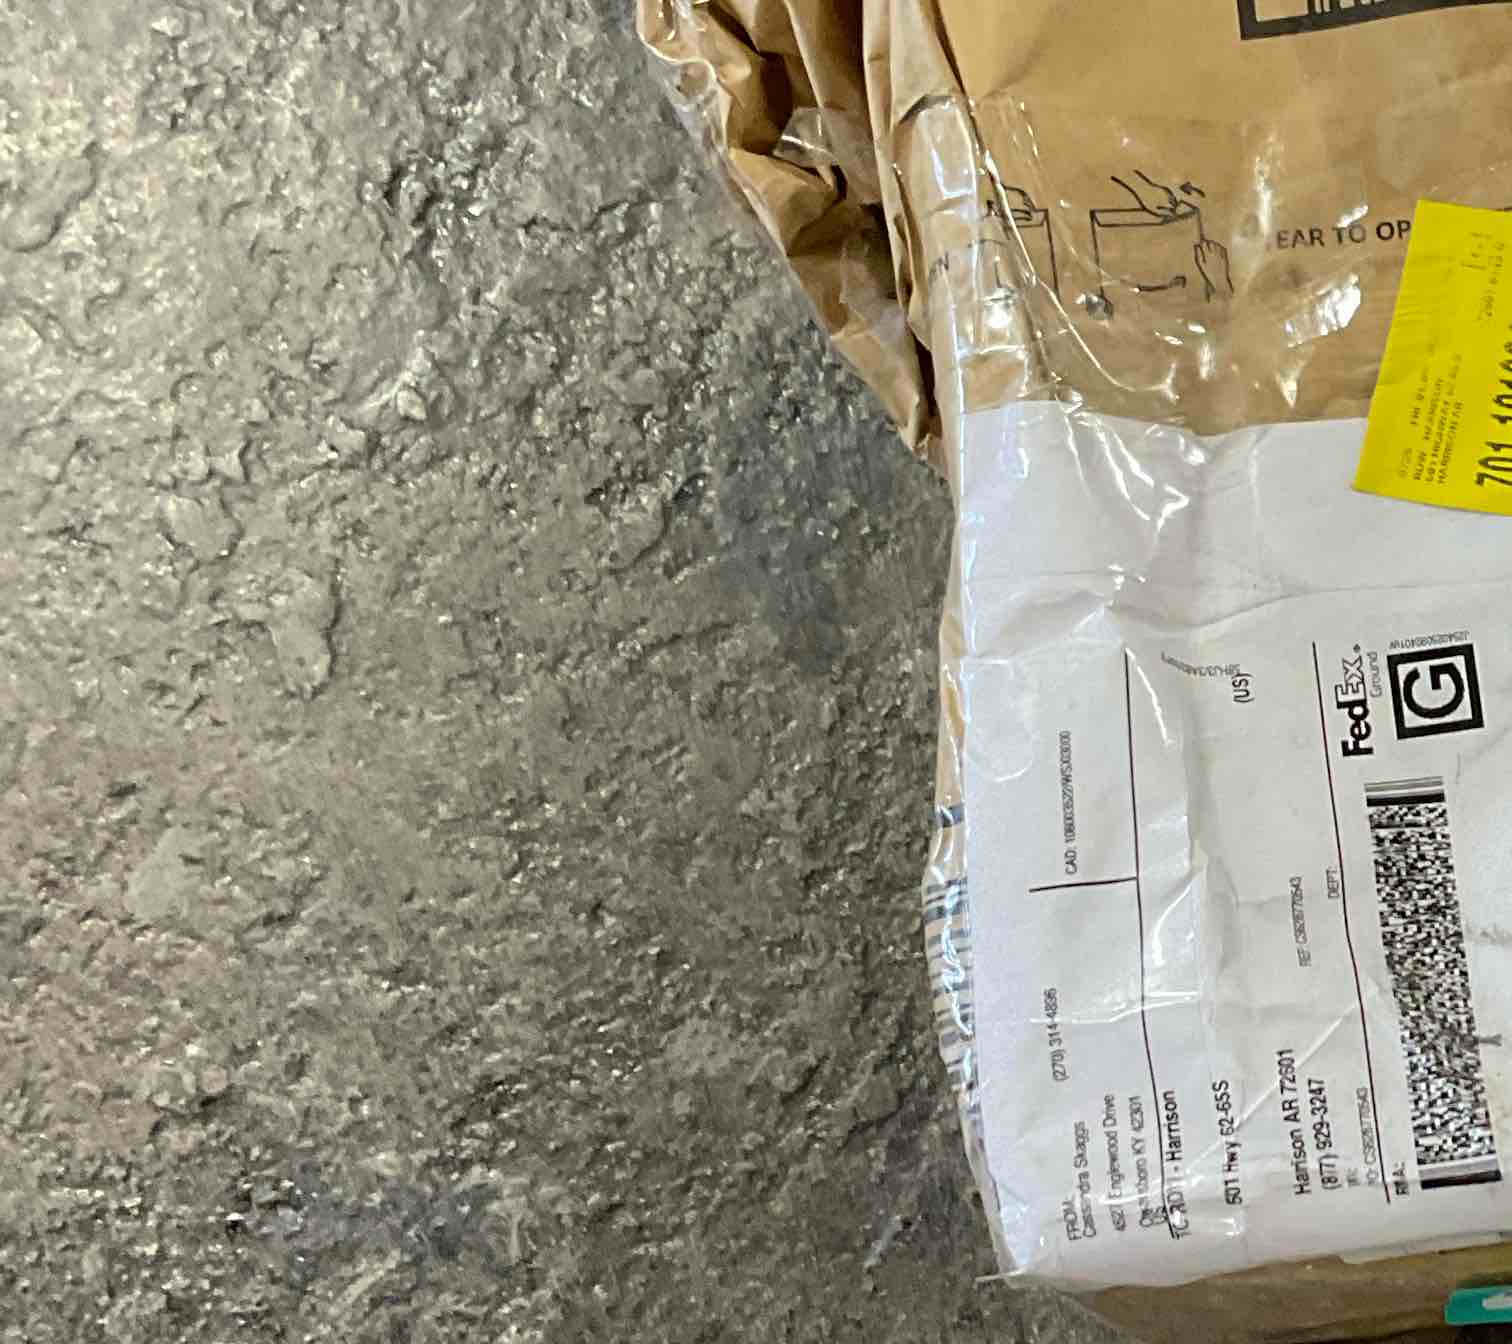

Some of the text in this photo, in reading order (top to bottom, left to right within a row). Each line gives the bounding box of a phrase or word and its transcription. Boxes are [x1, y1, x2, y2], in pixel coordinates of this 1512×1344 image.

[1268, 219, 1412, 249] EAR TO OP
[1231, 672, 1255, 703] (US)
[1366, 651, 1383, 698] Ground
[1402, 661, 1465, 719] G
[1334, 655, 1374, 757] FedEx
[1064, 846, 1078, 875] CAD:
[1050, 1049, 1069, 1082] (270)
[1275, 1048, 1297, 1094] 72601
[1102, 1094, 1117, 1128] Drive
[1128, 1095, 1145, 1132] 42301
[1162, 1089, 1182, 1161] Harrison
[1212, 1079, 1235, 1136] 62-65S
[1281, 1098, 1300, 1123] AR
[1072, 1121, 1089, 1168] Skaggs
[1131, 1136, 1145, 1154] KY
[1307, 1078, 1342, 1190] (877) 929-3247
[1103, 1131, 1125, 1198] Englewood
[1221, 1140, 1241, 1172] Hwy
